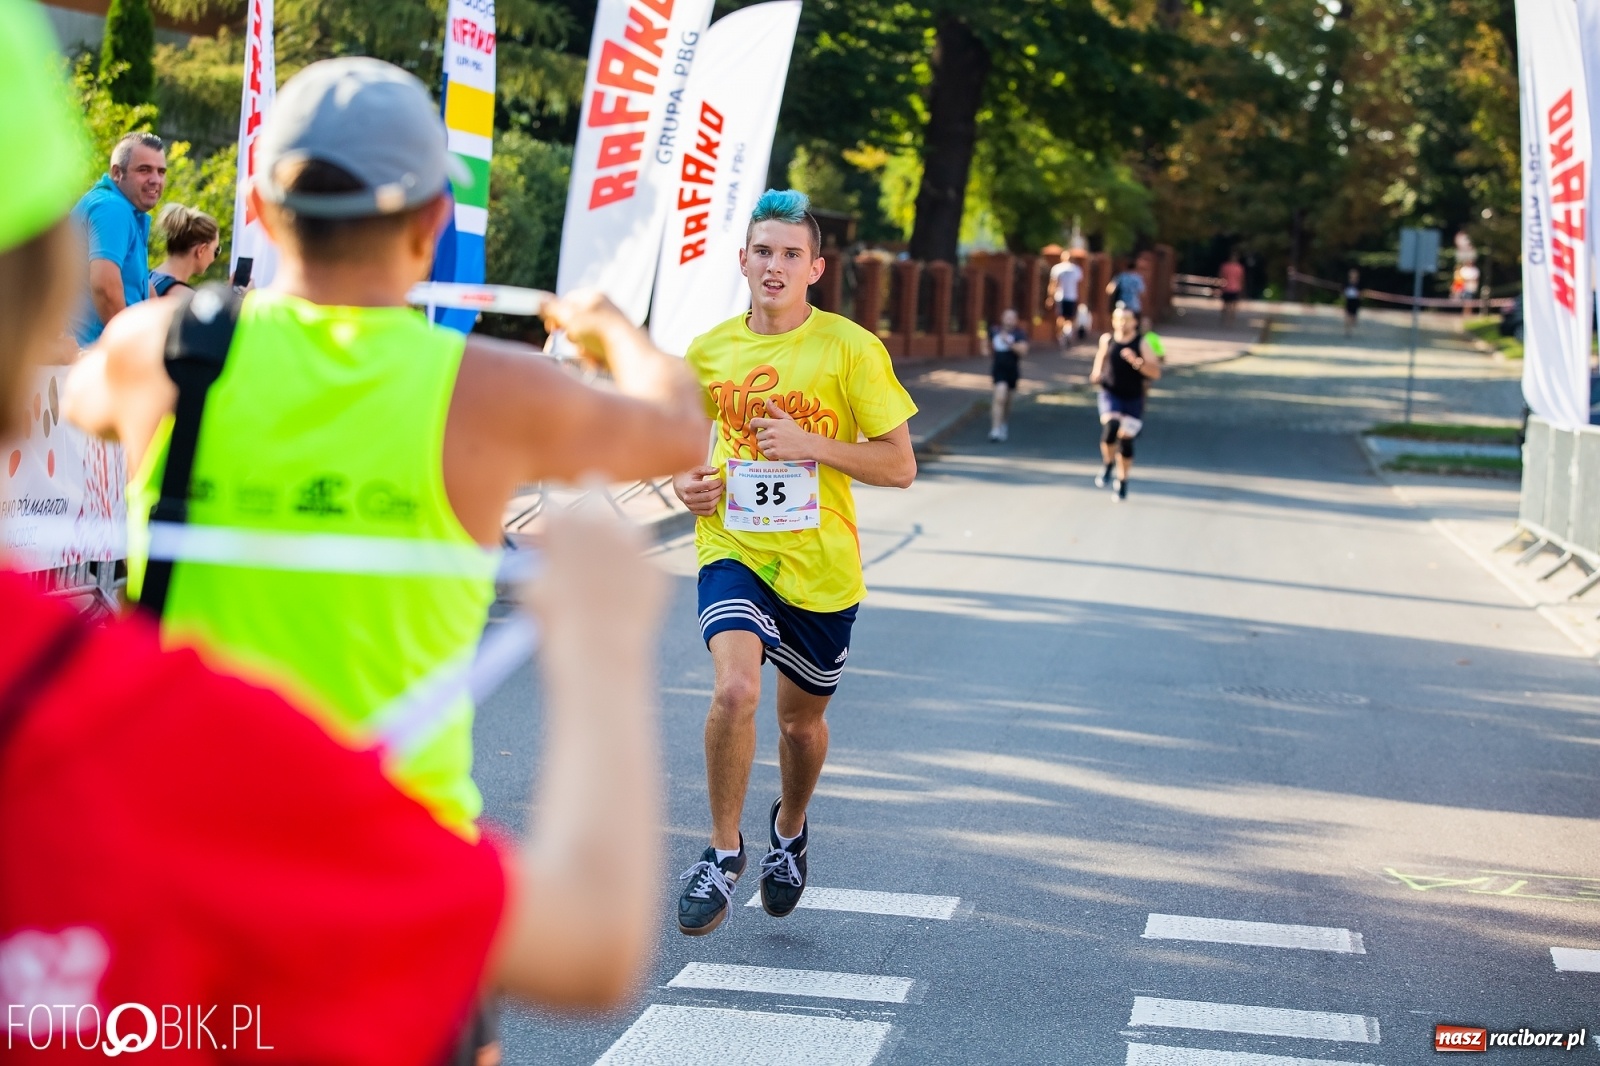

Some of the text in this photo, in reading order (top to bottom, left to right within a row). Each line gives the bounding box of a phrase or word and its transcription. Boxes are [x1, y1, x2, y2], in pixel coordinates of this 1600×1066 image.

[655, 30, 699, 165] GRUPA PBG
[678, 101, 725, 265] RAFAKO
[17, 494, 70, 517] PÓŁMARATON
[755, 481, 787, 506] 35
